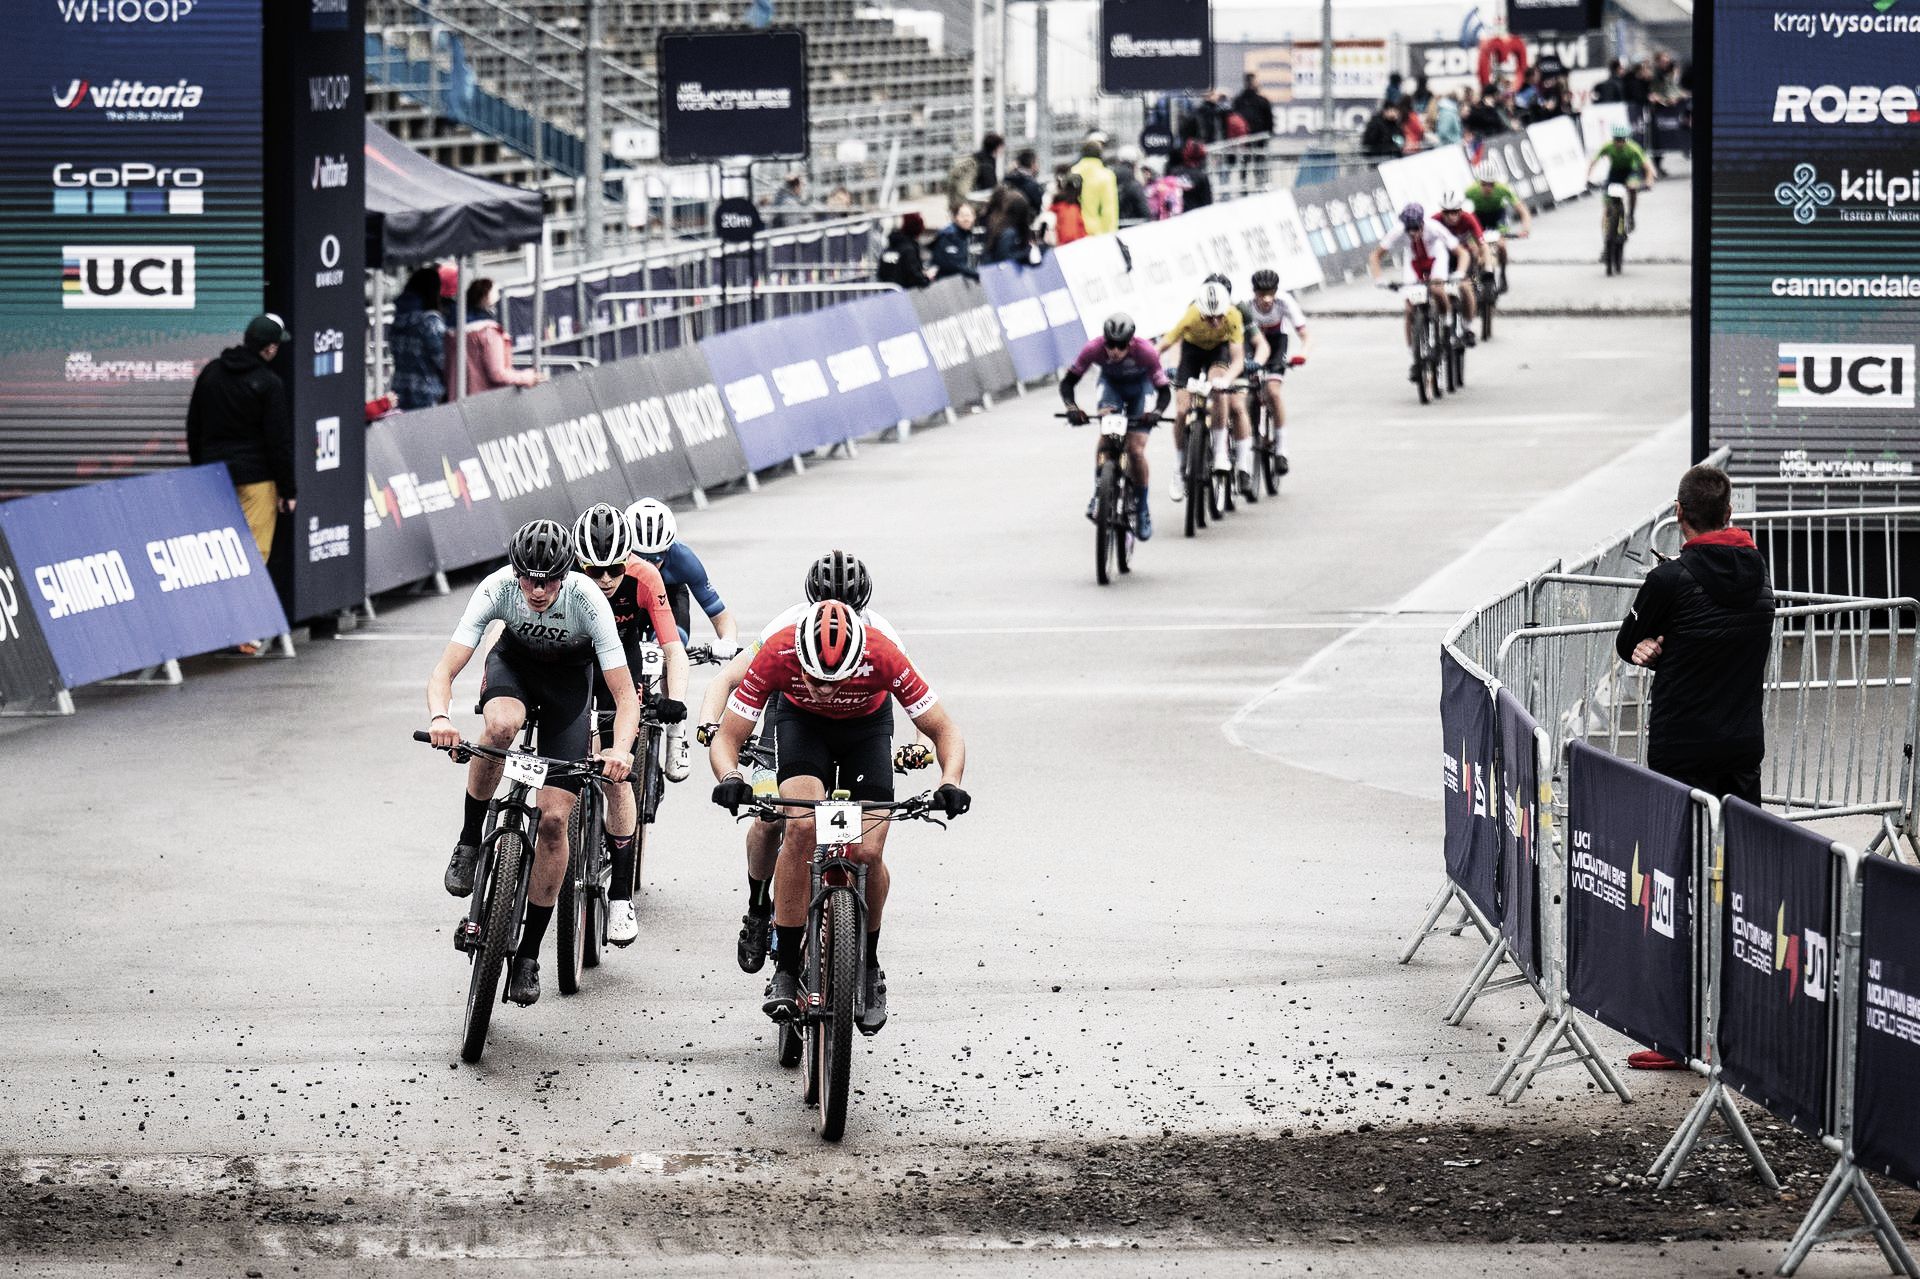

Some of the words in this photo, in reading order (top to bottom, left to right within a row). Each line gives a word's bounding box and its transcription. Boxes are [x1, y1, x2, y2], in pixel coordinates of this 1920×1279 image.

[1774, 12, 1816, 38] Kraj
[90, 79, 203, 108] vittoria
[53, 163, 204, 187] GoPro
[1841, 168, 1920, 207] kilpi
[87, 259, 182, 296] UCI
[1771, 275, 1920, 297] cannondale
[1803, 356, 1903, 394] UCI
[477, 429, 552, 501] WHOOP
[545, 413, 611, 483] WHOOP
[602, 396, 674, 464] WHOOP
[665, 383, 727, 447] WHOOP
[1780, 460, 1870, 472] MOUNTAIN
[35, 550, 135, 619] SHIMANO
[146, 527, 251, 592] SHIMANO
[517, 622, 570, 643] ROSE
[830, 810, 847, 829] 4
[1574, 830, 1591, 850] UCI
[1571, 850, 1612, 882] MOUNTAIN
[1571, 871, 1603, 898] WORLD
[1654, 880, 1671, 927] UCI
[1866, 982, 1907, 1015] MOUNTAIN
[1866, 1006, 1896, 1035] WORLD
